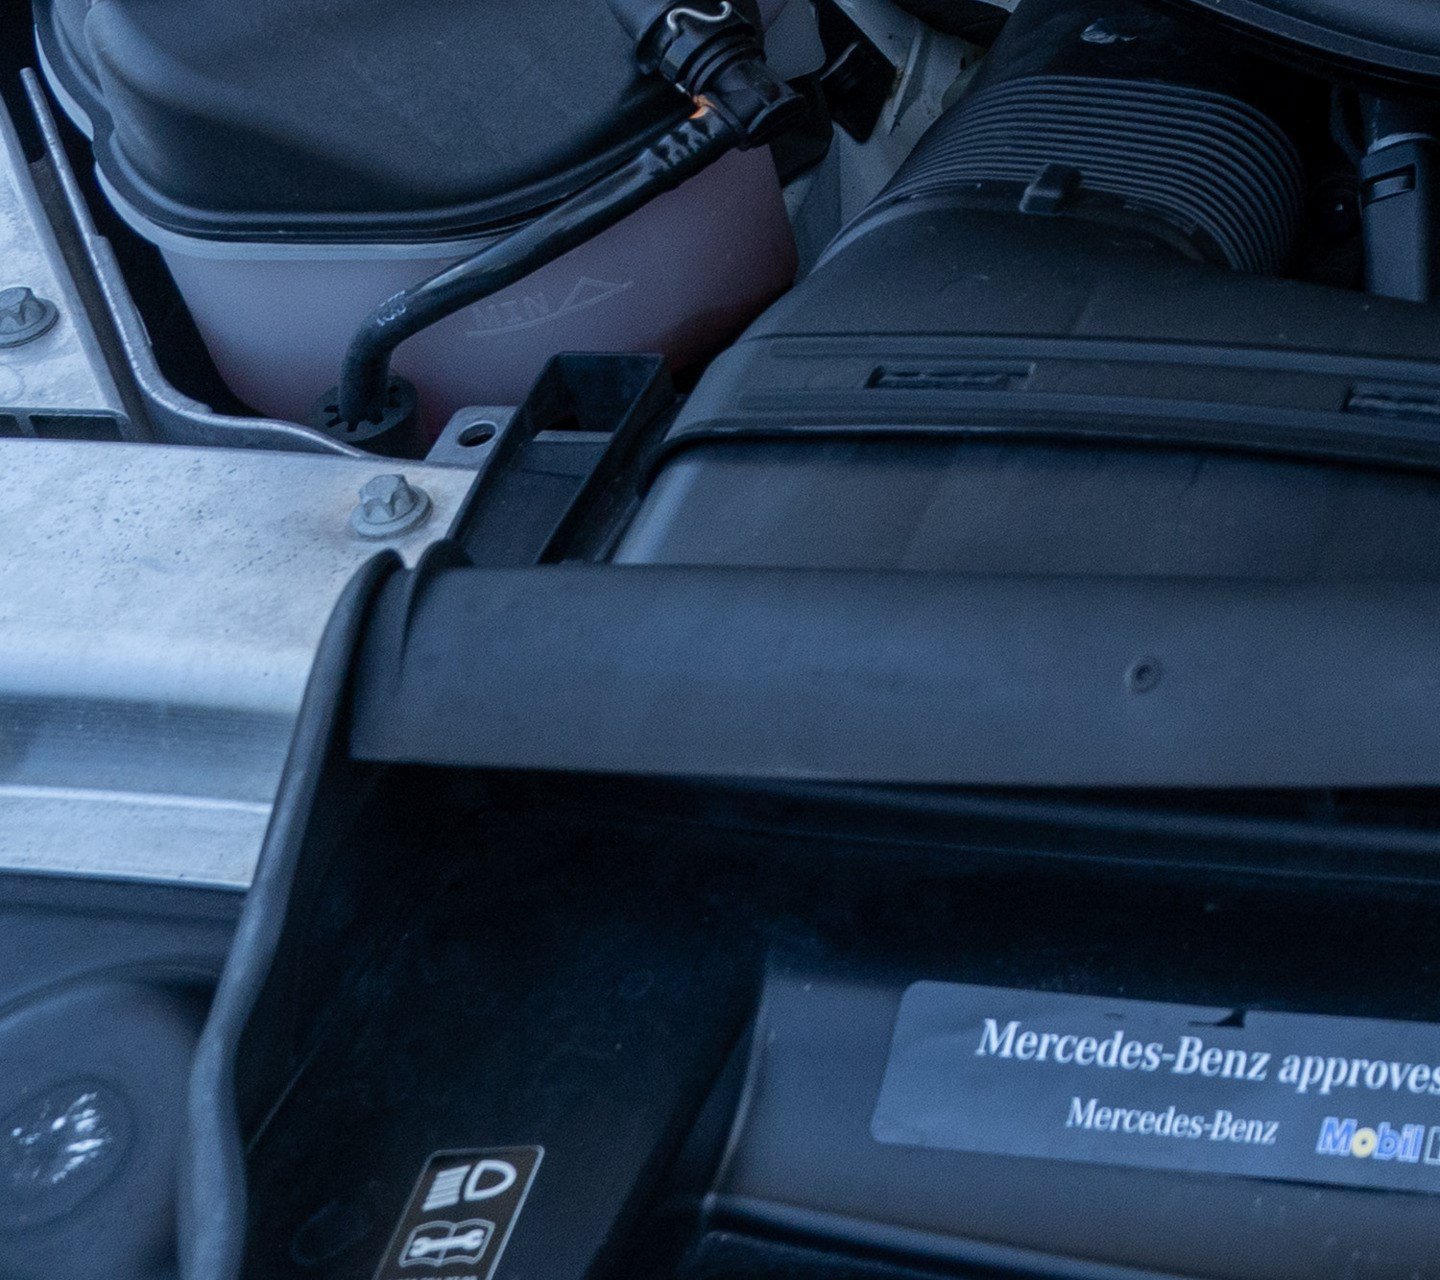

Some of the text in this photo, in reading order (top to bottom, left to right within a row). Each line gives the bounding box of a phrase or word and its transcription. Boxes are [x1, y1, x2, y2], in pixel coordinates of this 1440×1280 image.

[976, 1018, 1270, 1084] Mercedes-Benz
[1065, 1096, 1280, 1148] Mercedes-Benz
[1317, 1117, 1424, 1165] Mobil
